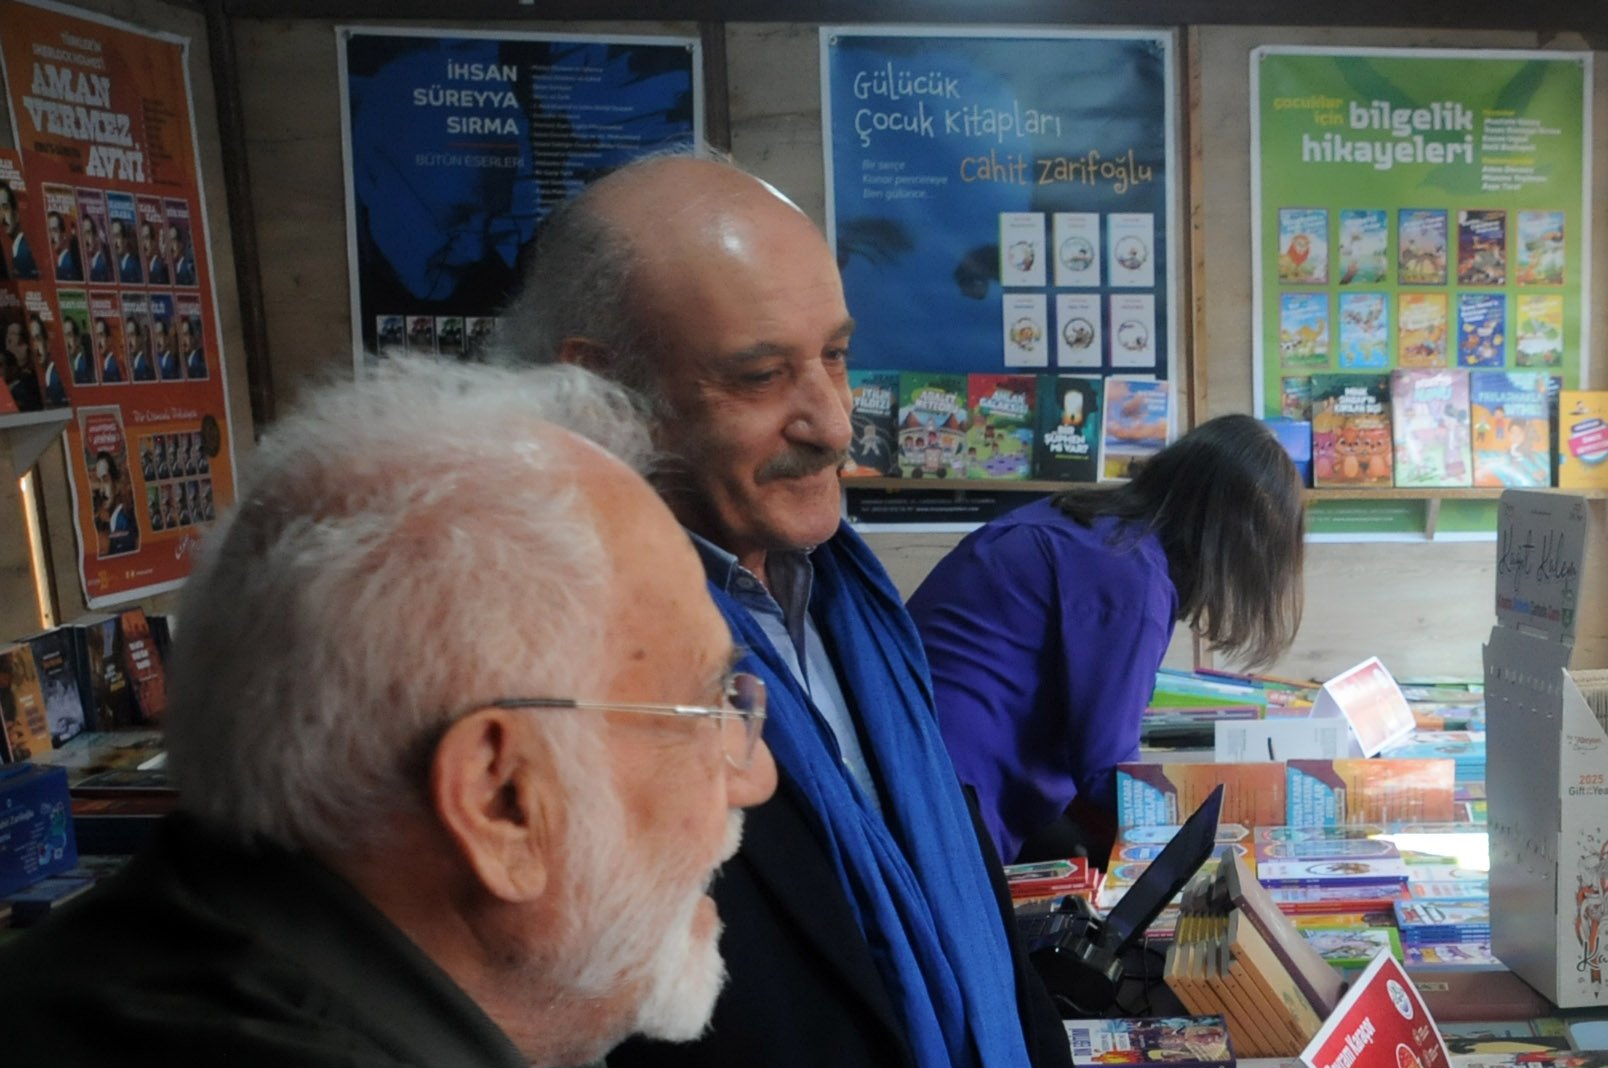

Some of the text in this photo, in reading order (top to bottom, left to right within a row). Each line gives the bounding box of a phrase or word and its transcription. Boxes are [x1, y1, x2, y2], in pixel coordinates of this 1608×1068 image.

[32, 62, 112, 109] AMAN
[447, 60, 517, 82] İHSAN
[853, 61, 960, 100] Gülücük
[413, 85, 519, 108] SÜREYYA
[22, 96, 134, 148] VERMEZ
[447, 117, 520, 136] SIRMA
[855, 101, 934, 148] Çocuk
[1350, 100, 1473, 137] bilgelik
[86, 142, 146, 184] AVNİ
[1302, 133, 1473, 170] hikayeleri
[1568, 786, 1585, 796] Gift
[1579, 774, 1604, 785] 2025
